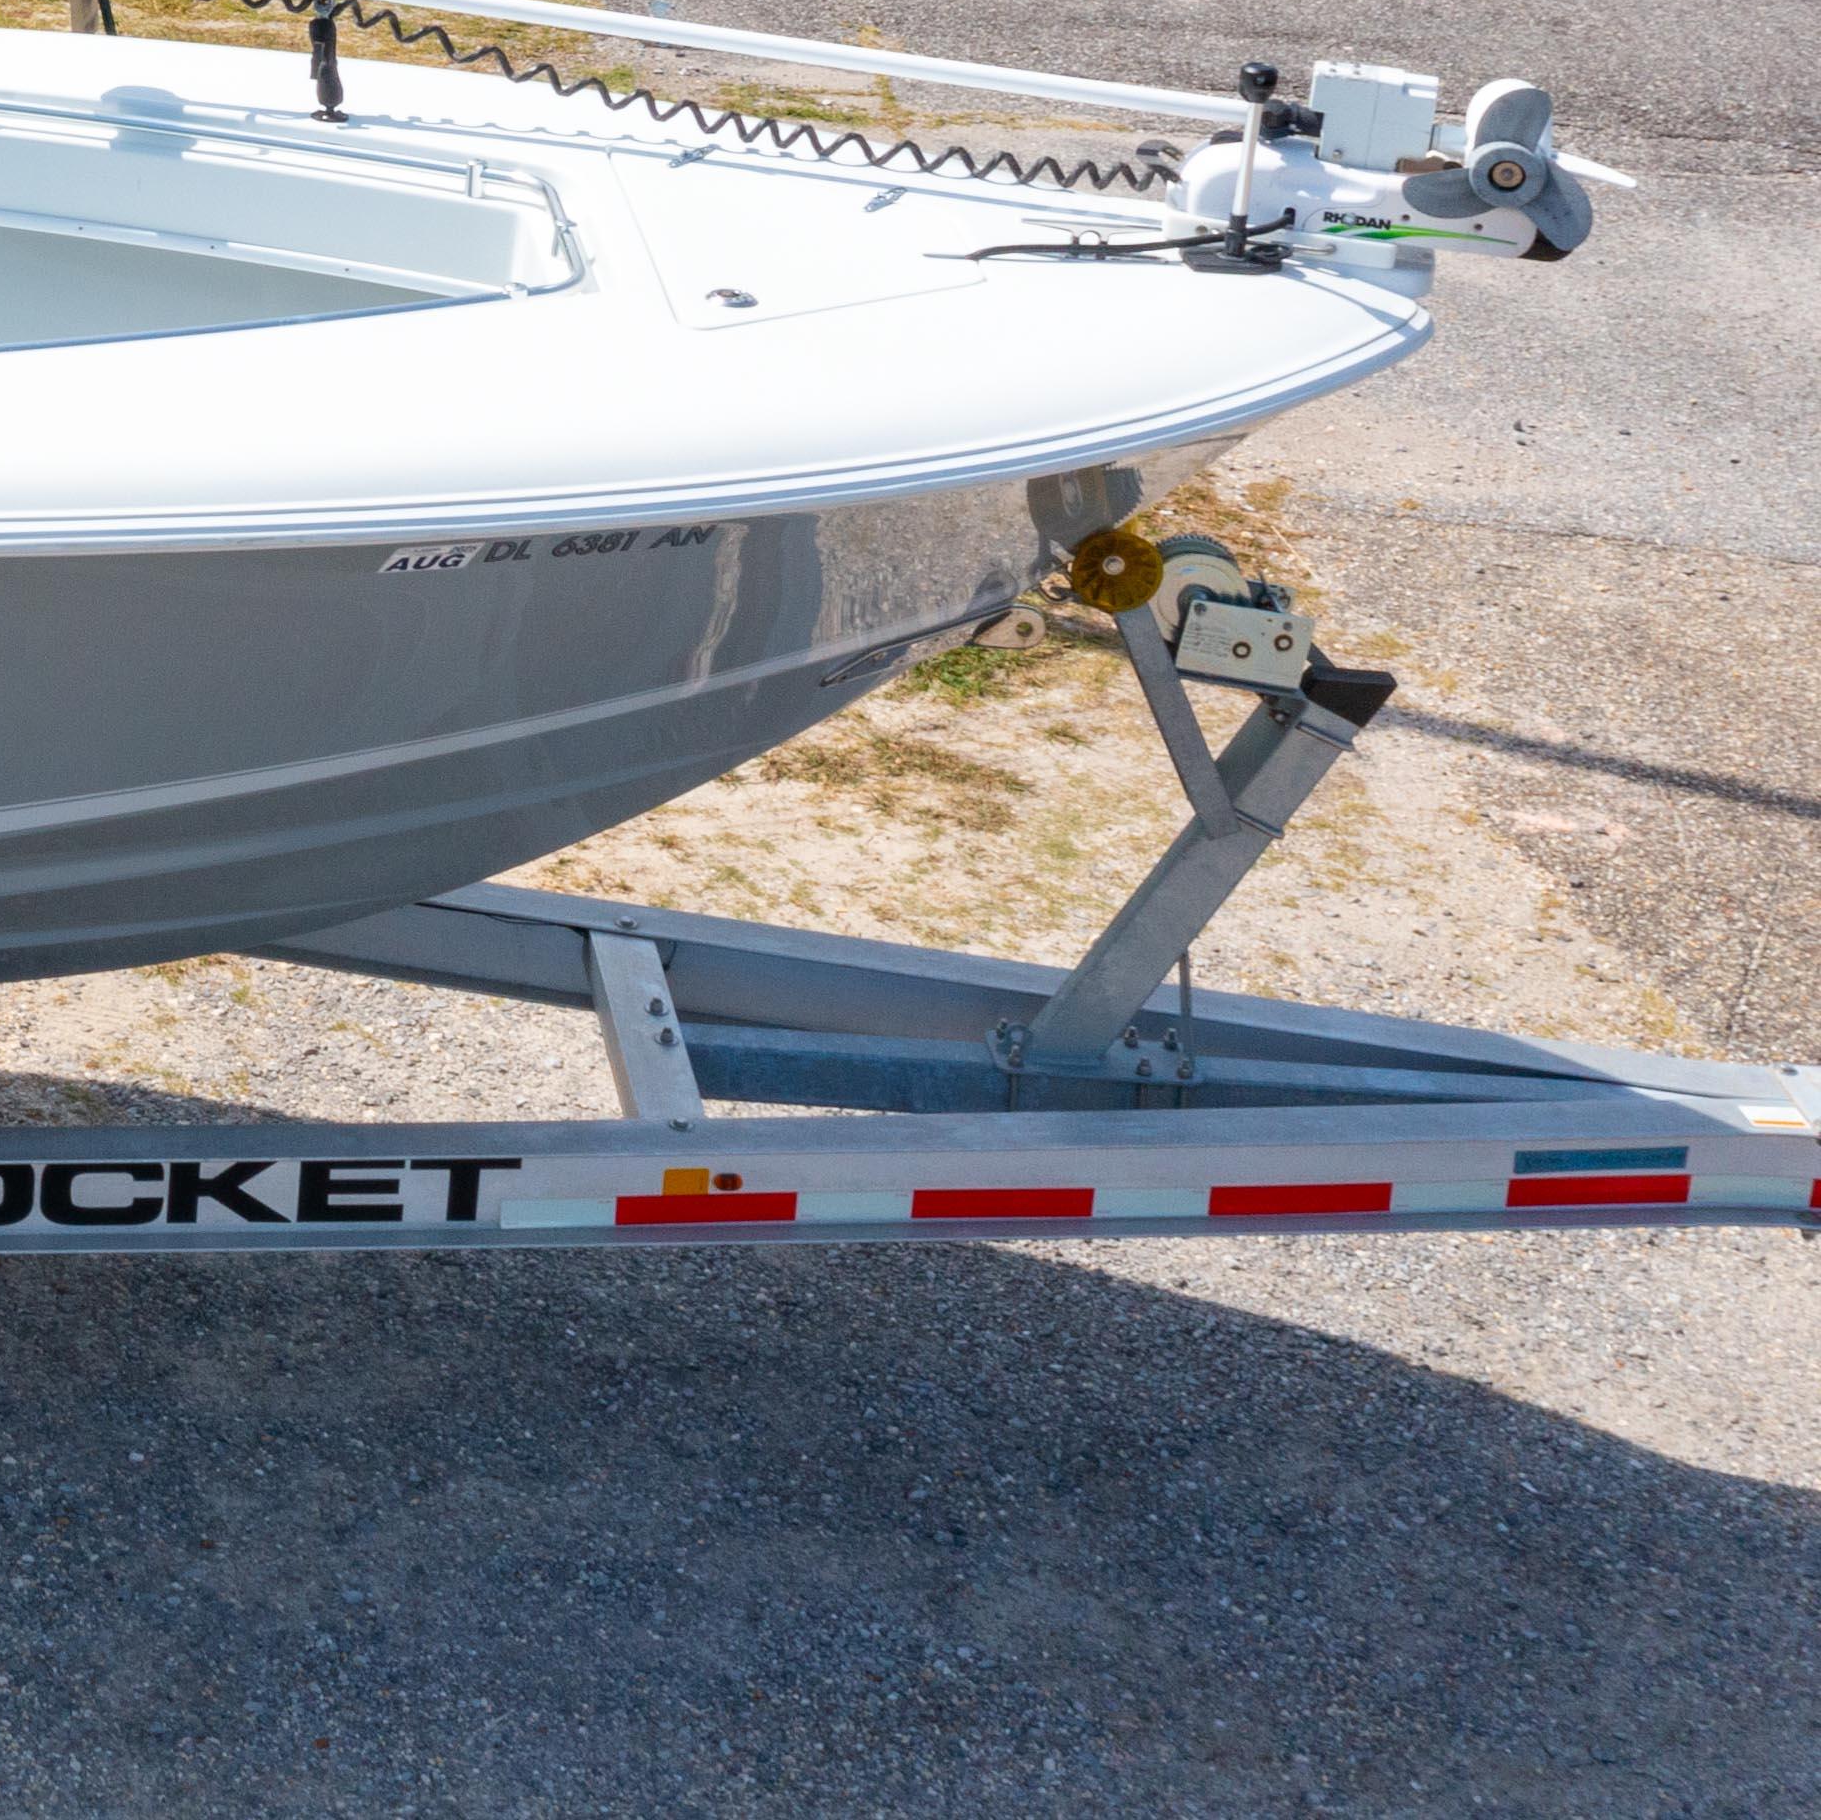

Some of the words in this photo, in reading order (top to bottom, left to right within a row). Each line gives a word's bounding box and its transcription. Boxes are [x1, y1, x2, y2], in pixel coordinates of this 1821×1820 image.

[483, 539, 533, 564] DL
[551, 530, 642, 558] 6381
[648, 523, 718, 549] AN
[385, 554, 466, 572] AUG
